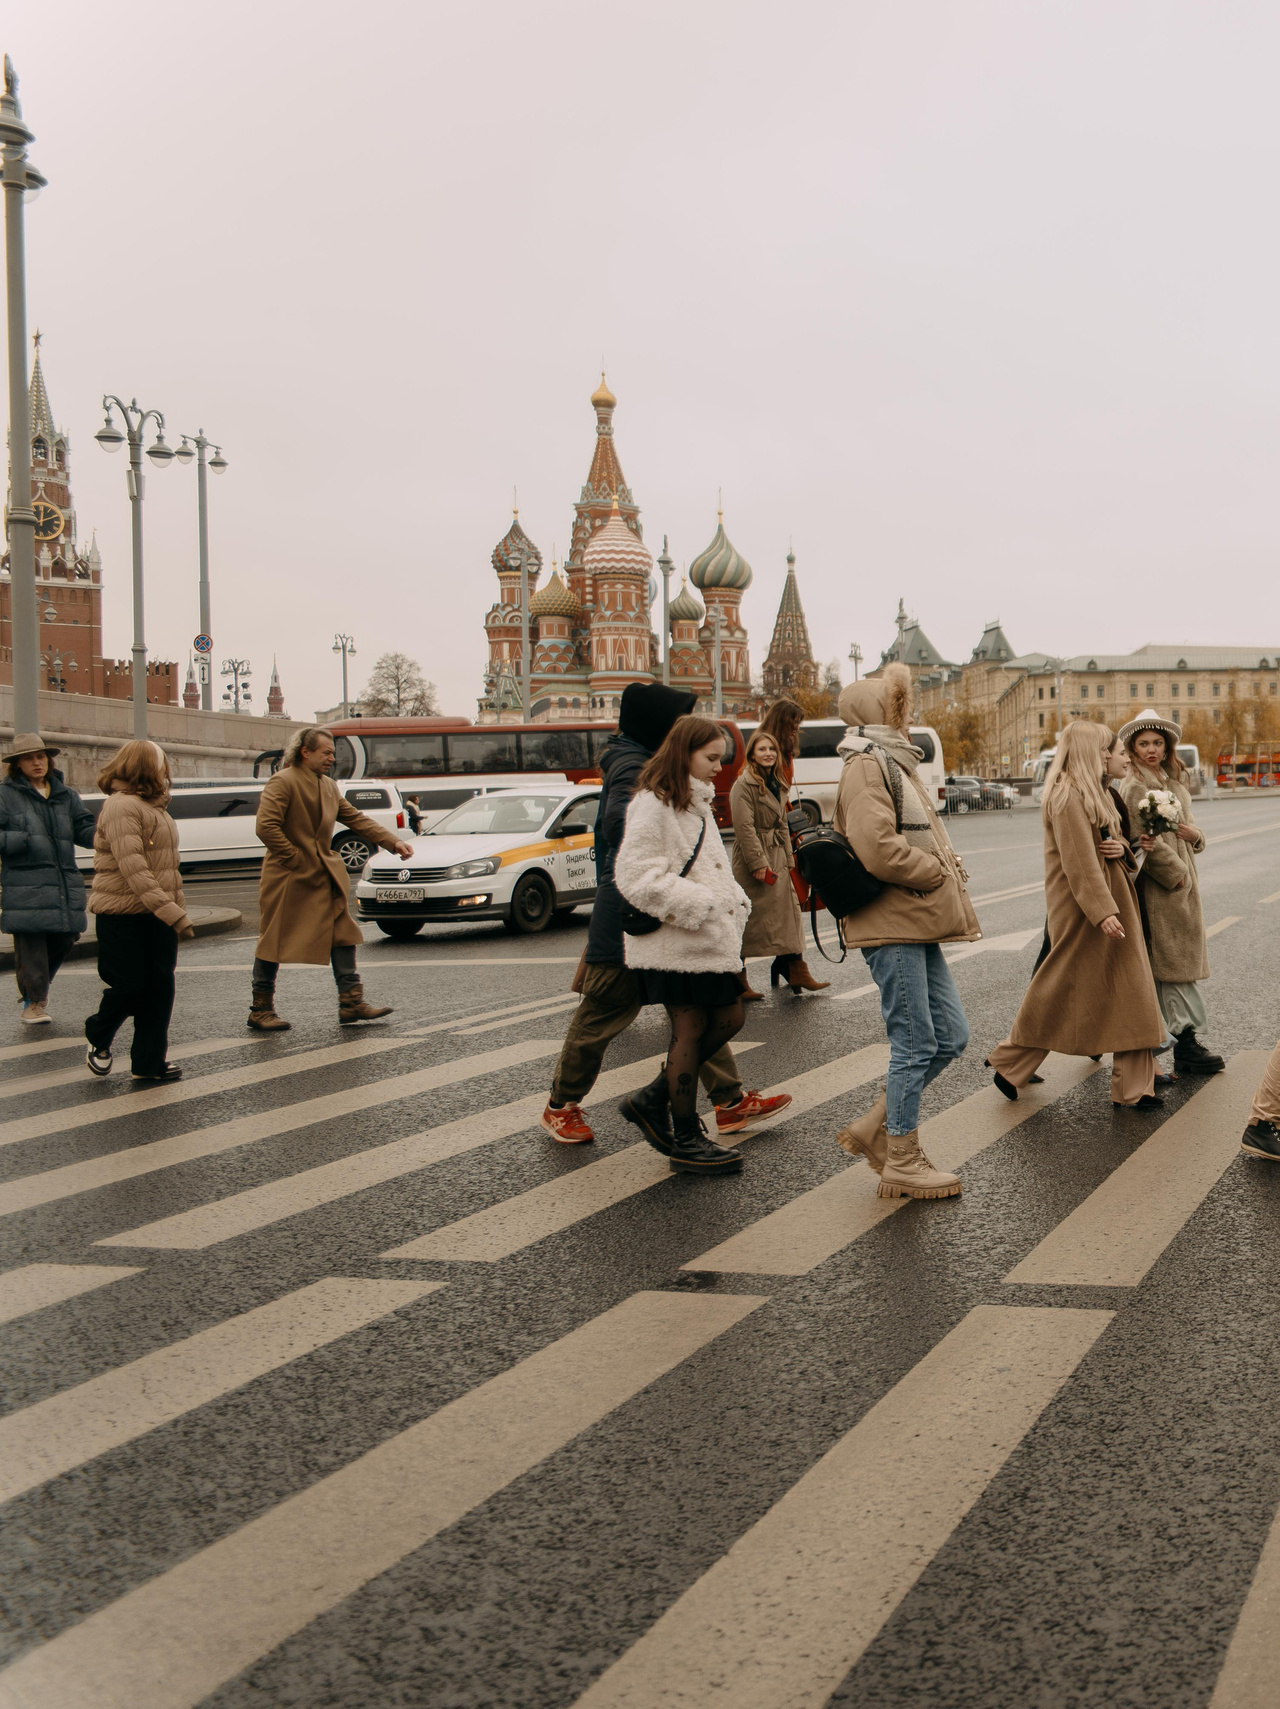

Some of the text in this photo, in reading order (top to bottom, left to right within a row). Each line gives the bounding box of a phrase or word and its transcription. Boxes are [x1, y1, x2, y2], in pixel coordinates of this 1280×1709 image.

[566, 853, 589, 864] Яндекс
[567, 868, 586, 878] Такси
[575, 880, 591, 890] (499)
